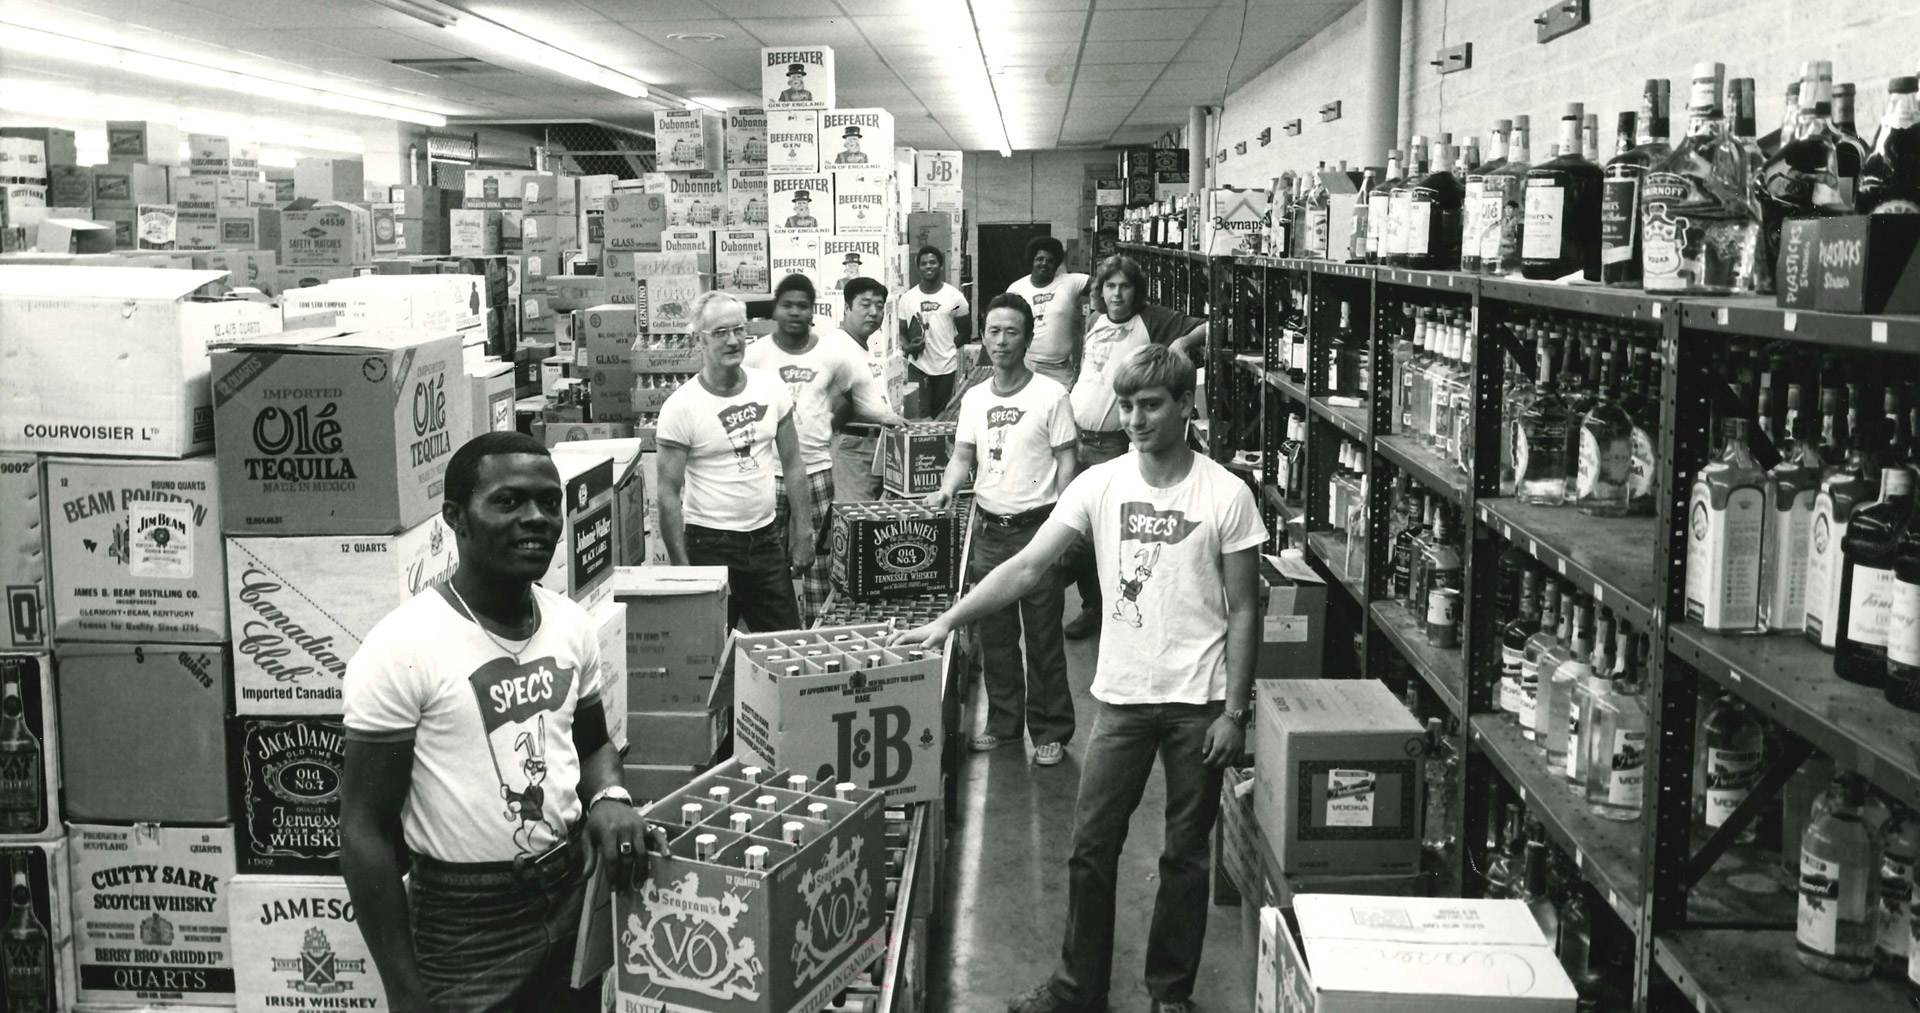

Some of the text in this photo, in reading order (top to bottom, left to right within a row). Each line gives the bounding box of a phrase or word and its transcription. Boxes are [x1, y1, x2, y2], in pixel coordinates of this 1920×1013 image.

[767, 51, 824, 67] BEEFEATER
[659, 119, 699, 130] Dubonnet
[732, 116, 767, 128] Dubonne
[824, 114, 880, 129] BEEFEATER
[770, 133, 814, 144] BEEFEATER
[927, 161, 952, 181] J&B
[671, 179, 722, 193] Dubonnet
[732, 178, 768, 189] Dubonne
[773, 178, 829, 194] BEEFEATER
[1644, 186, 1684, 196] IRNOFF
[839, 195, 882, 205] BEEFEATER
[1213, 216, 1264, 234] Bevnaps
[289, 239, 342, 248] SAFETY MATCHES
[611, 239, 634, 247] GLASS
[666, 240, 706, 250] Dubonnet
[721, 241, 763, 252] Dubonnet
[824, 242, 880, 256] BEEFEATER
[773, 259, 816, 271] BEEFEATER
[611, 295, 634, 303] GLASS
[640, 285, 648, 327] GENUINO
[596, 355, 620, 364] GLASS
[784, 369, 814, 380] SPEC'S
[263, 388, 343, 399] IMPORTED
[413, 372, 445, 437] Olé
[726, 404, 757, 427] SPEC'S
[991, 410, 1019, 423] SPEC'S
[24, 424, 134, 440] COURVOISIER
[253, 402, 343, 455] Olé
[411, 431, 451, 468] TEQUILA
[244, 458, 358, 482] TEQUILA
[60, 478, 68, 487] 12
[152, 481, 206, 490] ROUND QUARTS
[913, 473, 937, 486] WILD
[263, 482, 355, 492] MADE IN MEXICO
[63, 490, 116, 523] BEAM
[137, 513, 186, 535] JIM BEAM
[1128, 514, 1177, 536] SPEC'S
[874, 520, 939, 546] JACK DANIEL'S
[341, 543, 387, 553] 12 QUARTS
[582, 540, 607, 565] BLACK LABEL
[898, 548, 915, 557] Old
[875, 571, 938, 583] TENNESSEE WHISKEY
[74, 588, 200, 599] JAMES B. BEAM DISTILLING CO.
[12, 593, 38, 641] Q
[153, 610, 194, 618] KENTUCKY
[79, 622, 106, 630] Famous
[110, 622, 122, 630] for
[158, 623, 178, 631] Since
[135, 646, 144, 664] S
[197, 653, 211, 669] 12
[178, 651, 213, 688] QUARTS
[242, 686, 342, 700] Imported Canadia
[490, 666, 553, 713] SPEC'S
[855, 694, 871, 704] RARE
[258, 723, 346, 760] JACK DANIE
[816, 705, 912, 789] J&B
[286, 749, 331, 758] OLD TIME
[297, 768, 320, 779] Old
[295, 780, 324, 790] No.7
[1332, 804, 1369, 812] VODKA
[272, 806, 340, 828] Tenness
[83, 842, 128, 850] SCOTLAND
[270, 834, 340, 847] WHISK
[190, 845, 222, 853] QUARTS
[91, 865, 219, 894] CUTTY SARK
[734, 876, 760, 889] QUARTS
[94, 894, 217, 912] SCOTCH WHISKY
[662, 892, 717, 915] Seagram's
[260, 898, 356, 925] JAMESO
[817, 893, 850, 942] VO
[661, 921, 718, 977] VO
[95, 948, 132, 962] BERRY
[171, 951, 206, 964] RUDD
[114, 970, 206, 989] QUARTS
[265, 996, 377, 1008] IRISH WHISKEY
